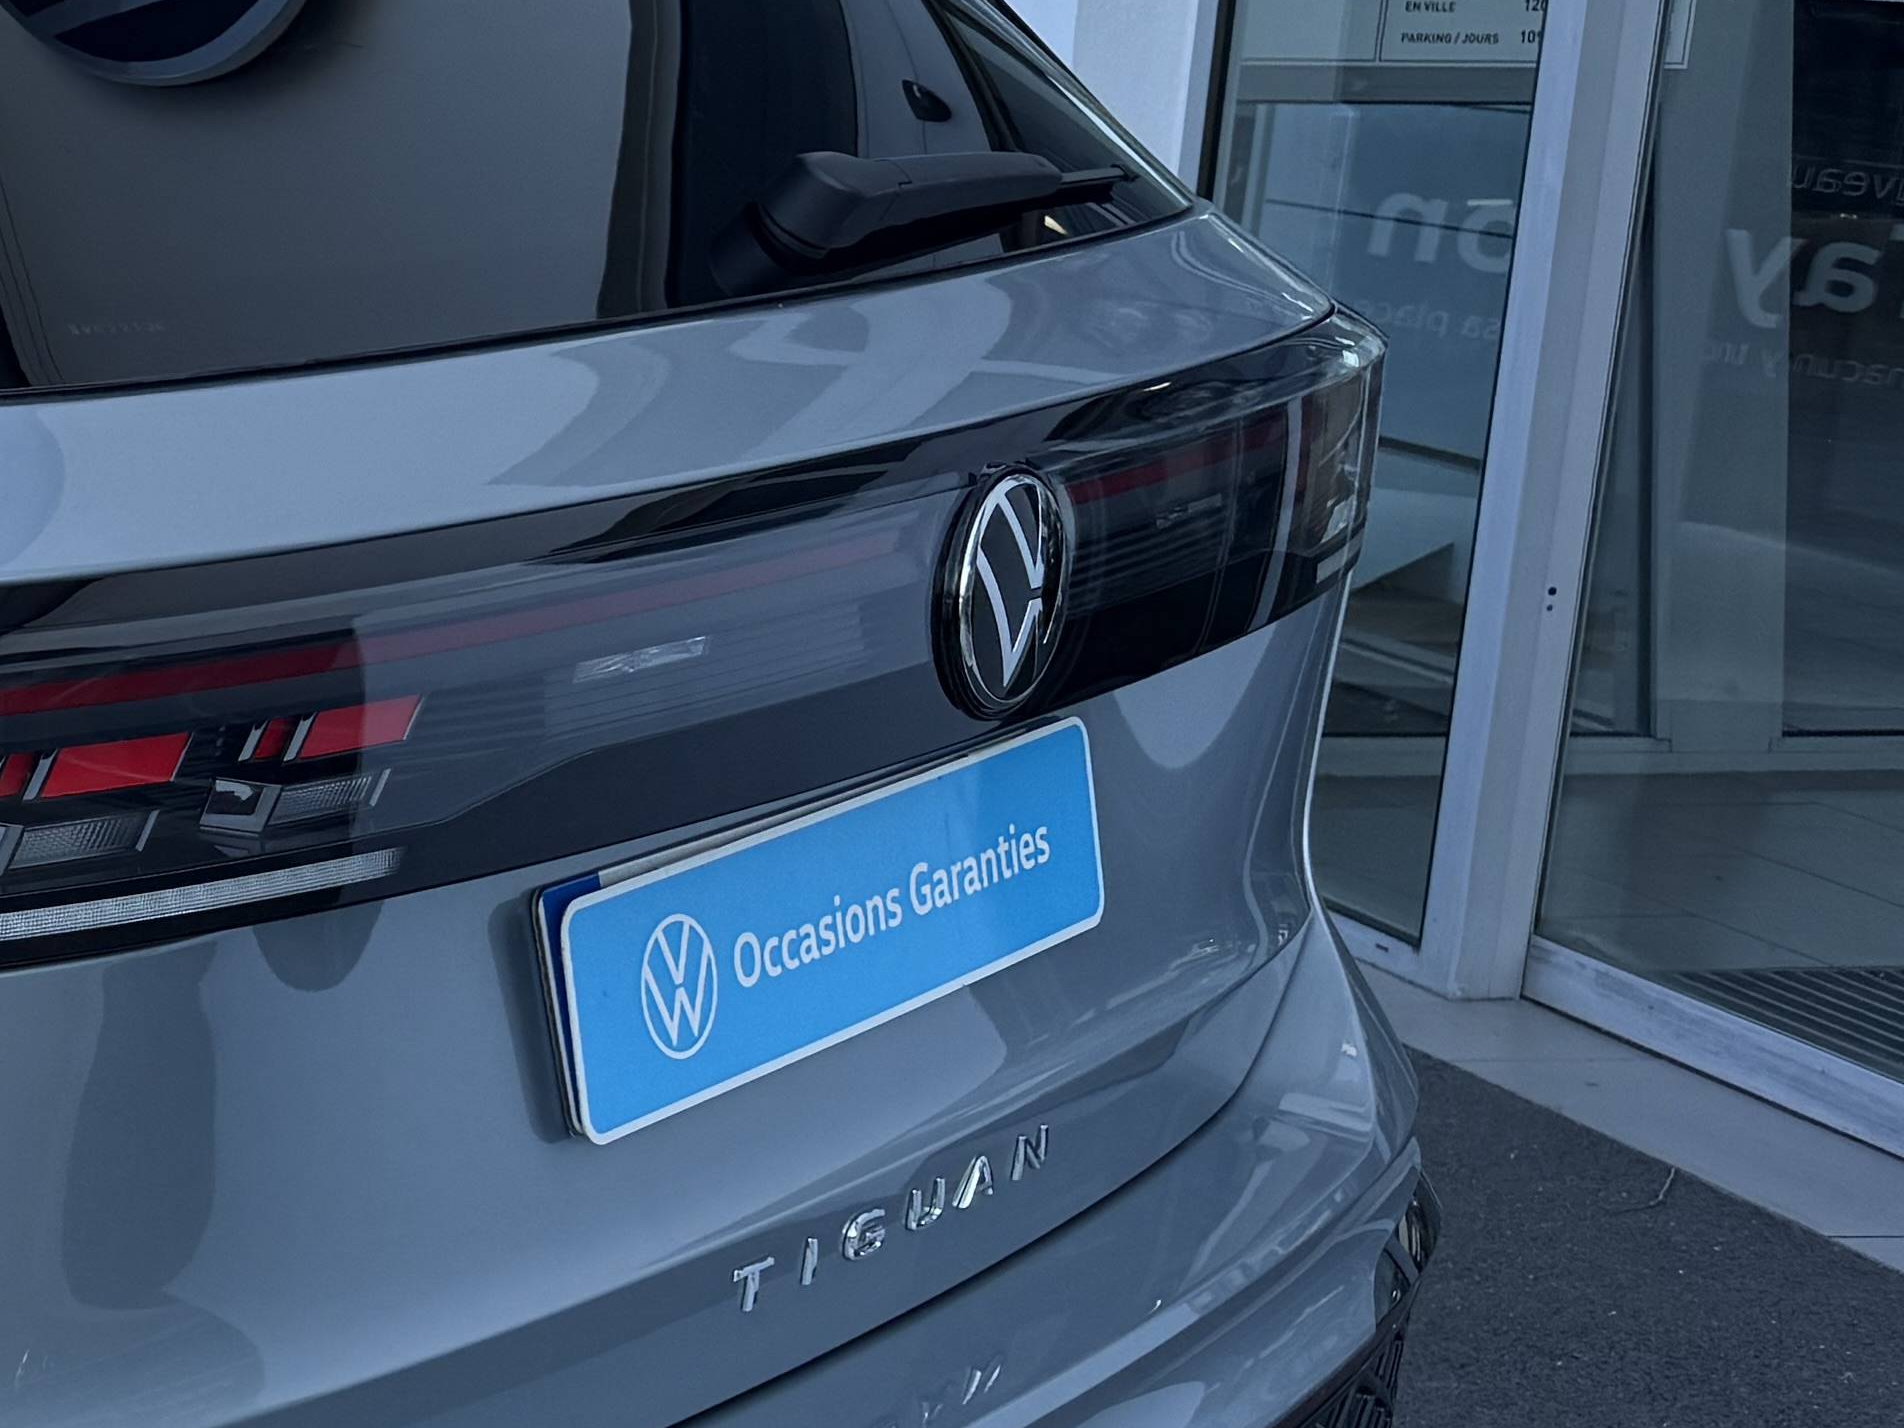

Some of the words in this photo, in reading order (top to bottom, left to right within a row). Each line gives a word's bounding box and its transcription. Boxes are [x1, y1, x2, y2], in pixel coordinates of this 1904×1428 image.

[1400, 32, 1452, 45] PARKING
[1462, 32, 1500, 46] JOURS
[1405, 1, 1421, 13] EN
[1424, 1, 1457, 13] VILLE
[733, 889, 904, 989] Occasions
[908, 822, 1052, 917] Garanties
[732, 1123, 1050, 1313] TIGUAN
